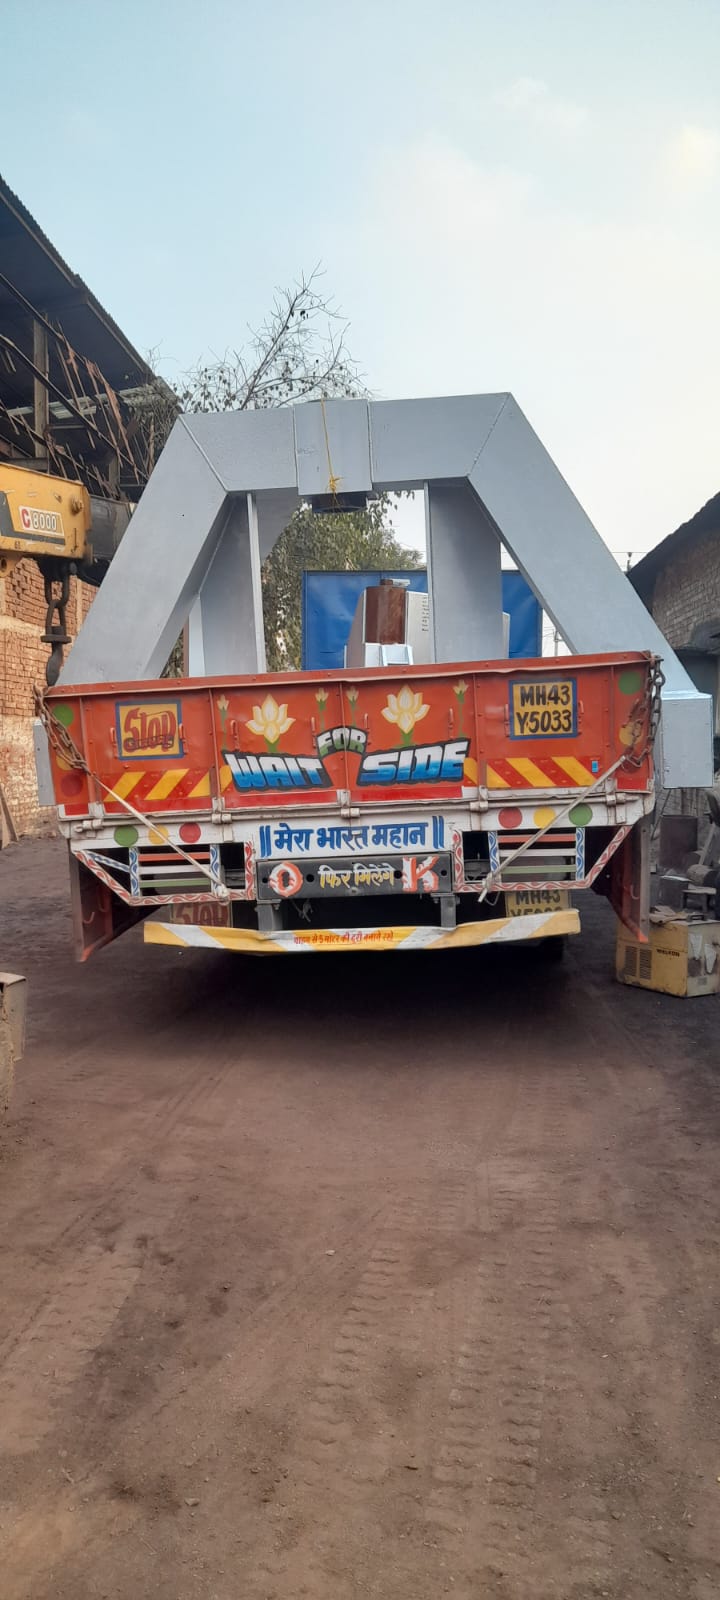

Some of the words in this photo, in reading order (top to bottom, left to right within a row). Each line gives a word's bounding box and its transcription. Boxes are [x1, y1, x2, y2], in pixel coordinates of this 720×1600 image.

[224, 752, 326, 789] WAIT
[317, 727, 367, 757] FOR
[360, 740, 469, 784] SIDE
[274, 823, 314, 852] मेरा
[317, 825, 369, 850] भारत
[371, 822, 429, 849] महान
[318, 864, 352, 889] फिर
[402, 856, 439, 892] K
